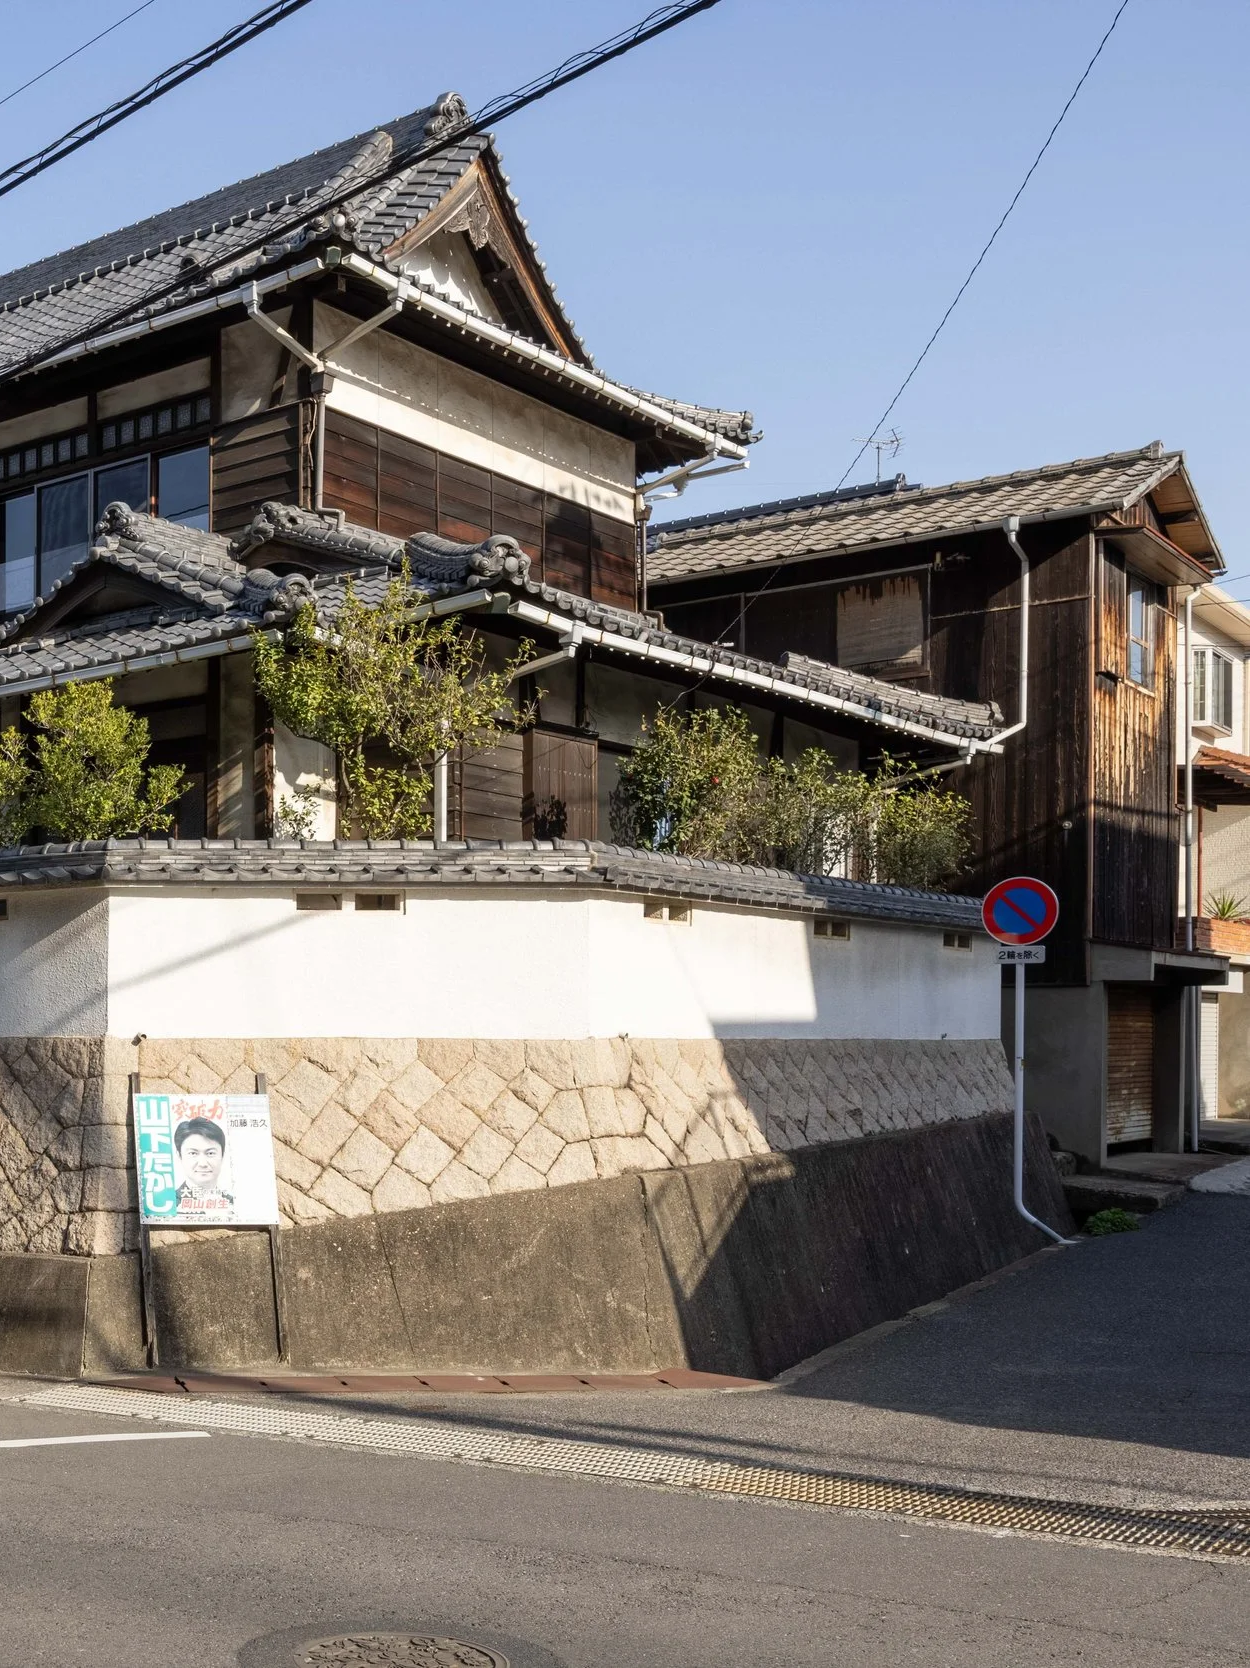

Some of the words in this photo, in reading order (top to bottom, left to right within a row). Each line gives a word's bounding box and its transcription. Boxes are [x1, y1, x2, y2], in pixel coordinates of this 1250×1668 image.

[998, 950, 1040, 960] 2輪を除く
[139, 1099, 174, 1212] 山下たかし
[181, 1198, 229, 1209] 岡山創生
